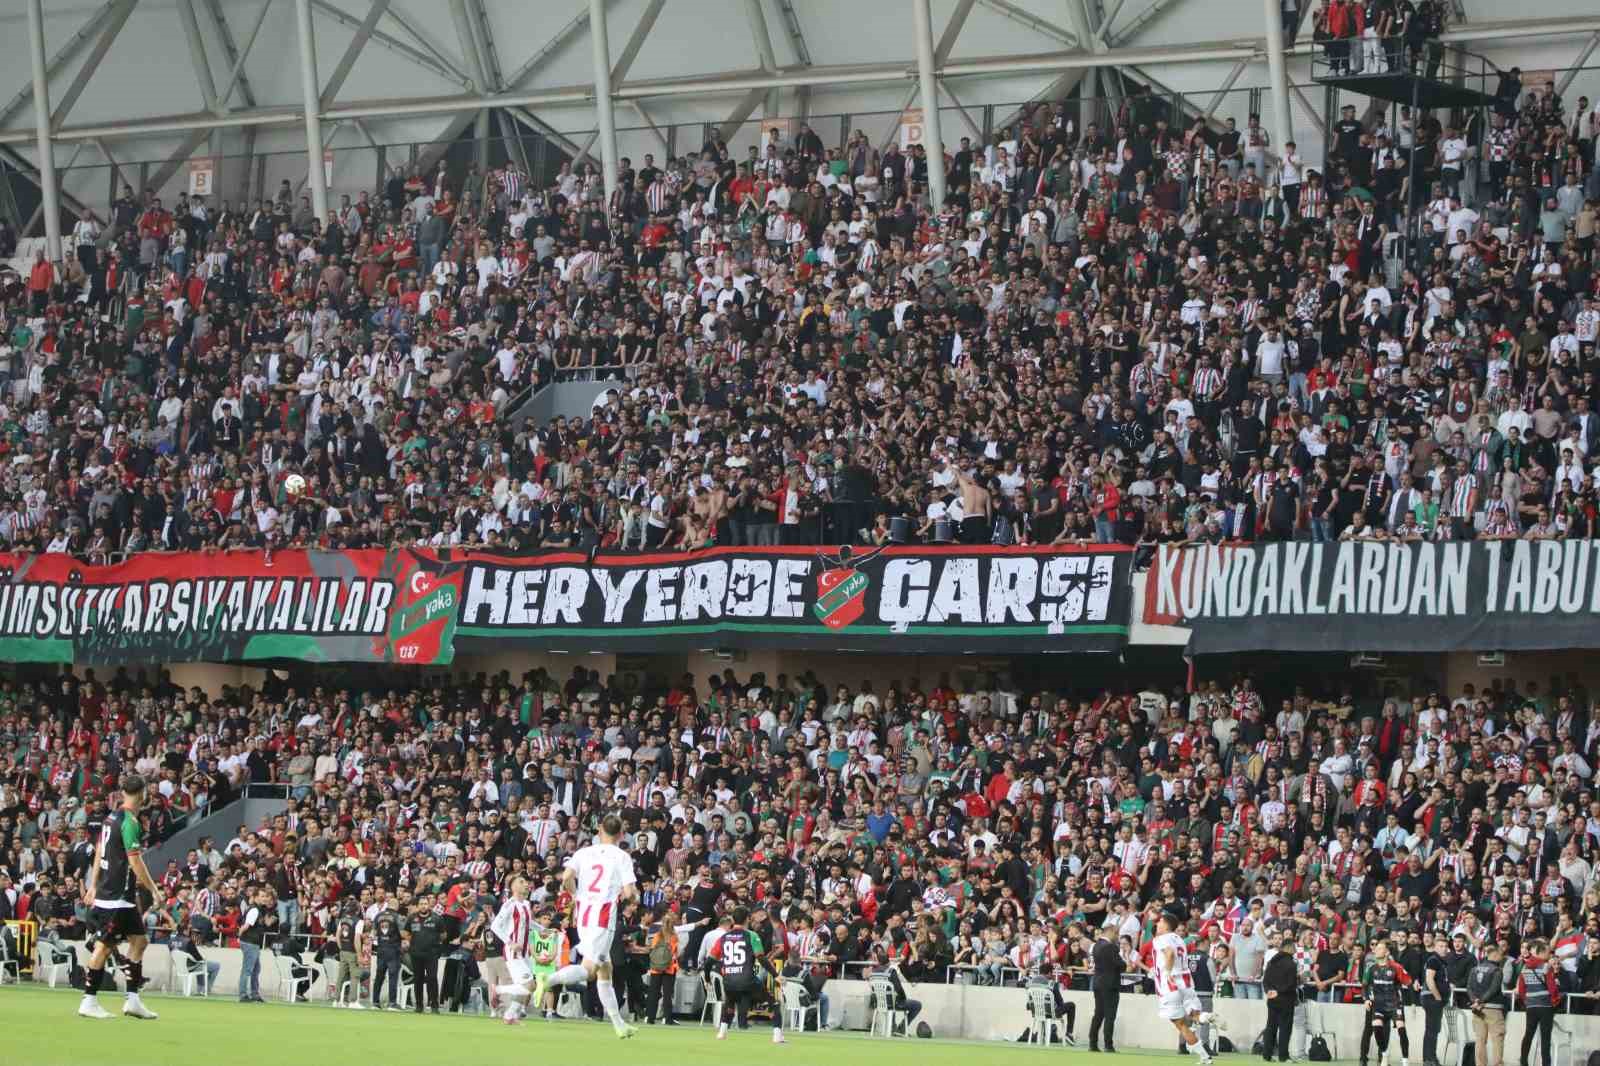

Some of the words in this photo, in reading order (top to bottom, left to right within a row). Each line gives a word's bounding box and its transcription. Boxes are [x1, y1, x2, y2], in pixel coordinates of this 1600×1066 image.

[878, 556, 1115, 634] ÇARŞI
[1157, 542, 1471, 617] KUNDAKLARDAN
[588, 863, 604, 893] 2
[723, 940, 746, 965] 95
